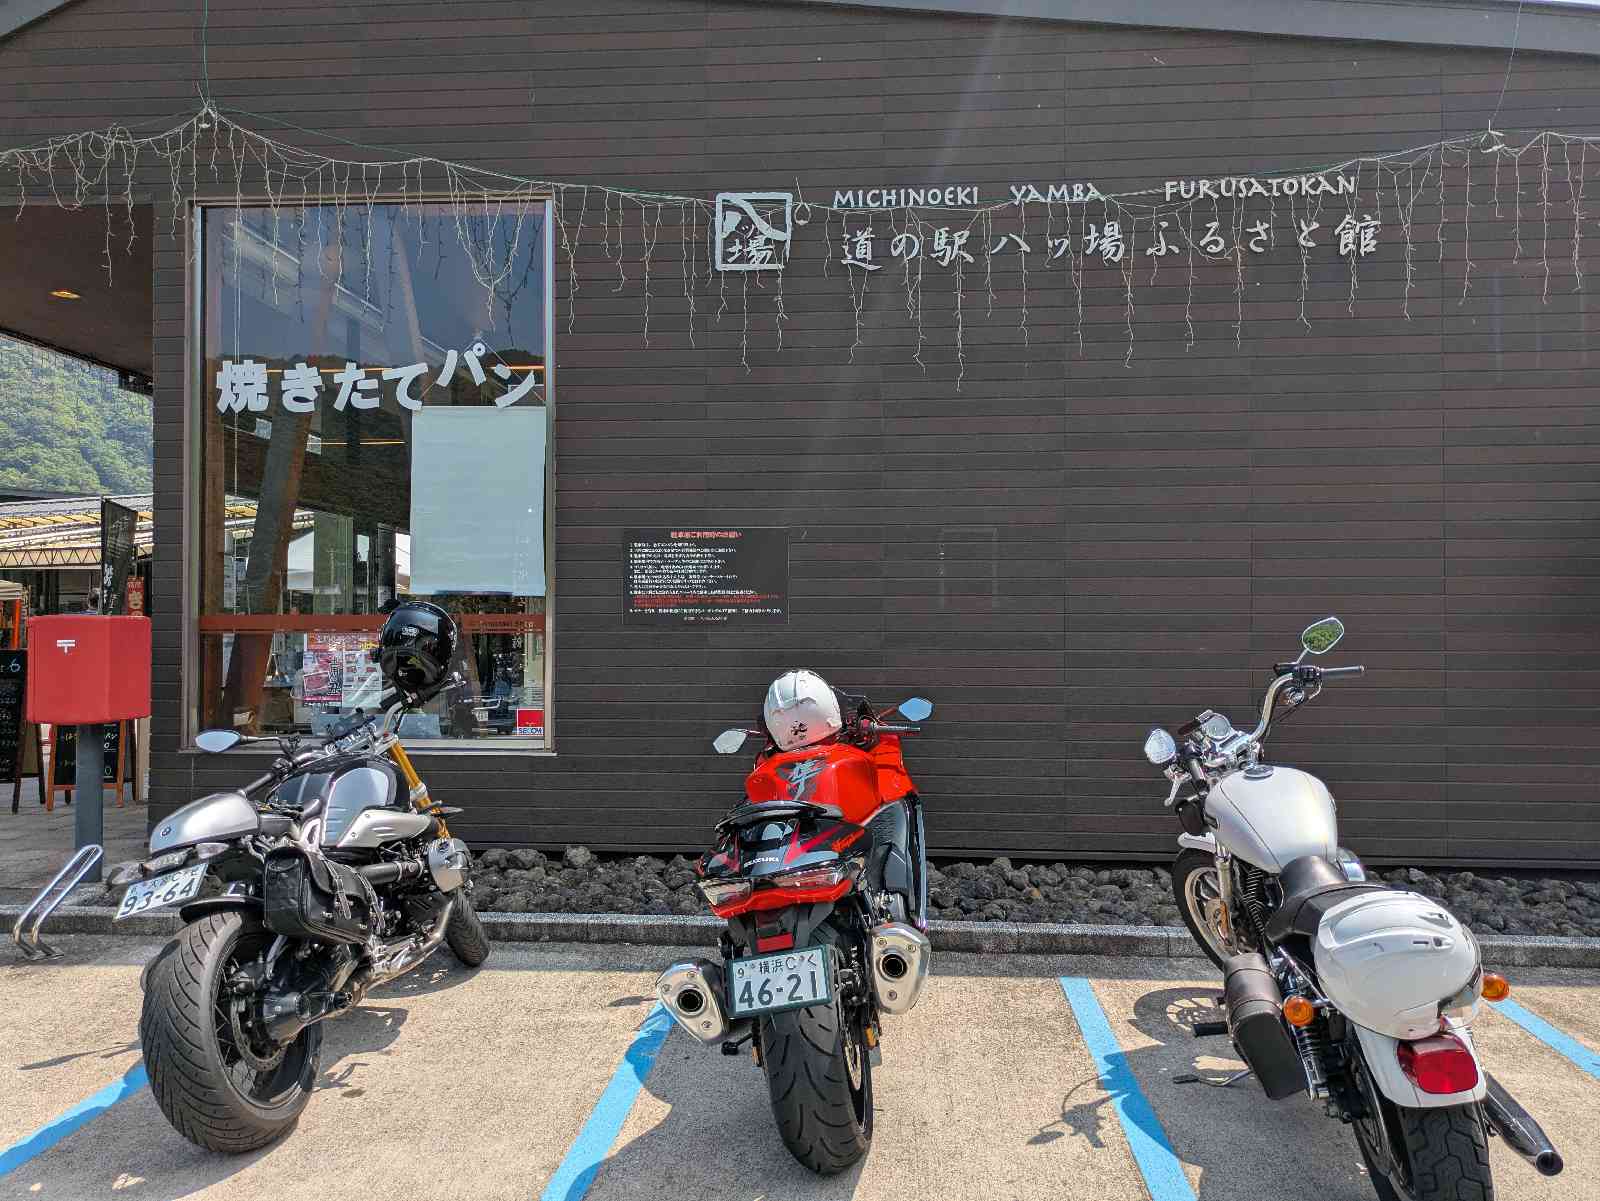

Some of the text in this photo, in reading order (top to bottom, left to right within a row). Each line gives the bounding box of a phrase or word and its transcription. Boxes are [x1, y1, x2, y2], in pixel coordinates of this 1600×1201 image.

[833, 175, 1356, 208] MICHINOEKI YAMBA FURUSATOKAN
[216, 342, 536, 412] 焼きたてパン
[120, 878, 195, 915] 93-64
[738, 971, 818, 1009] 46-21
